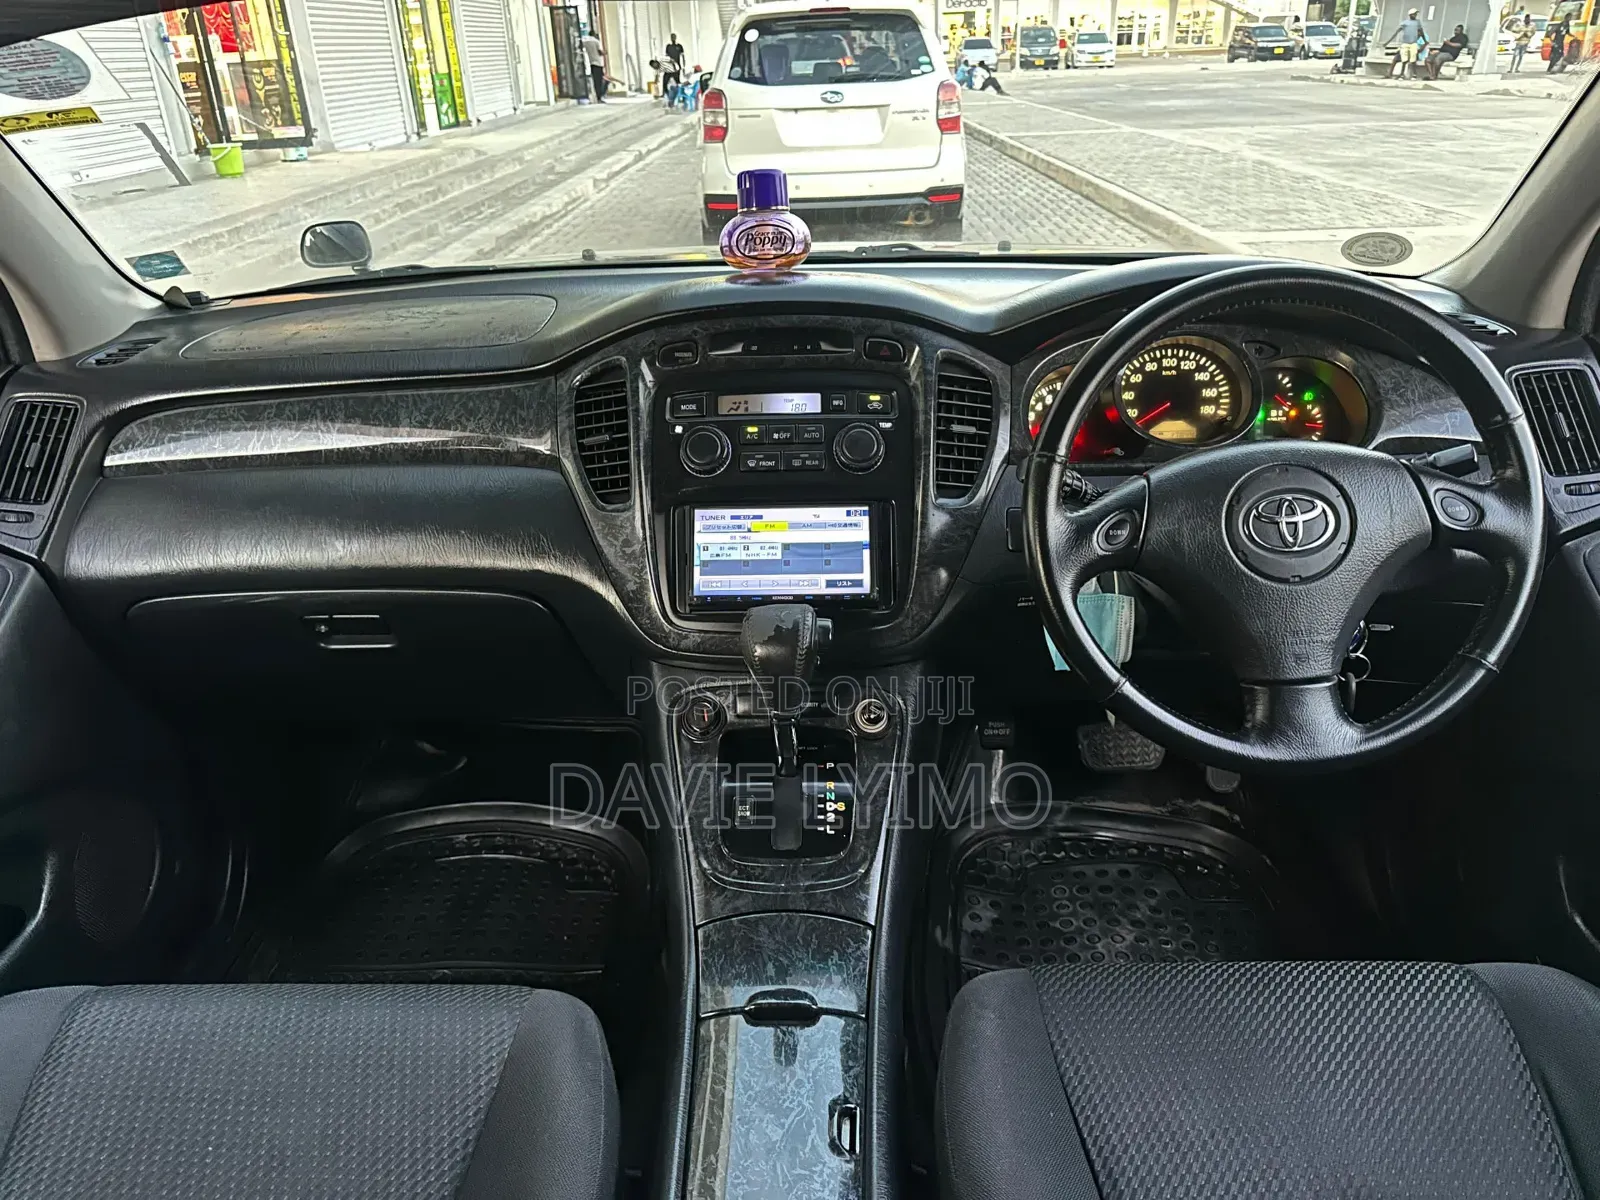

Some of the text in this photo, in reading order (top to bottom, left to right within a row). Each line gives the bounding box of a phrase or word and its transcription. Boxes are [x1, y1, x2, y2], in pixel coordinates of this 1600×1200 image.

[744, 232, 787, 248] Poppy
[1144, 358, 1196, 371] 80 100 120
[1129, 372, 1210, 383] 60 140
[1122, 388, 1218, 400] 40 160
[1127, 405, 1216, 417] 20 180
[826, 762, 835, 770] P
[826, 781, 835, 790] R
[826, 791, 835, 801] N
[826, 812, 836, 823] 2
[826, 824, 835, 835] L
